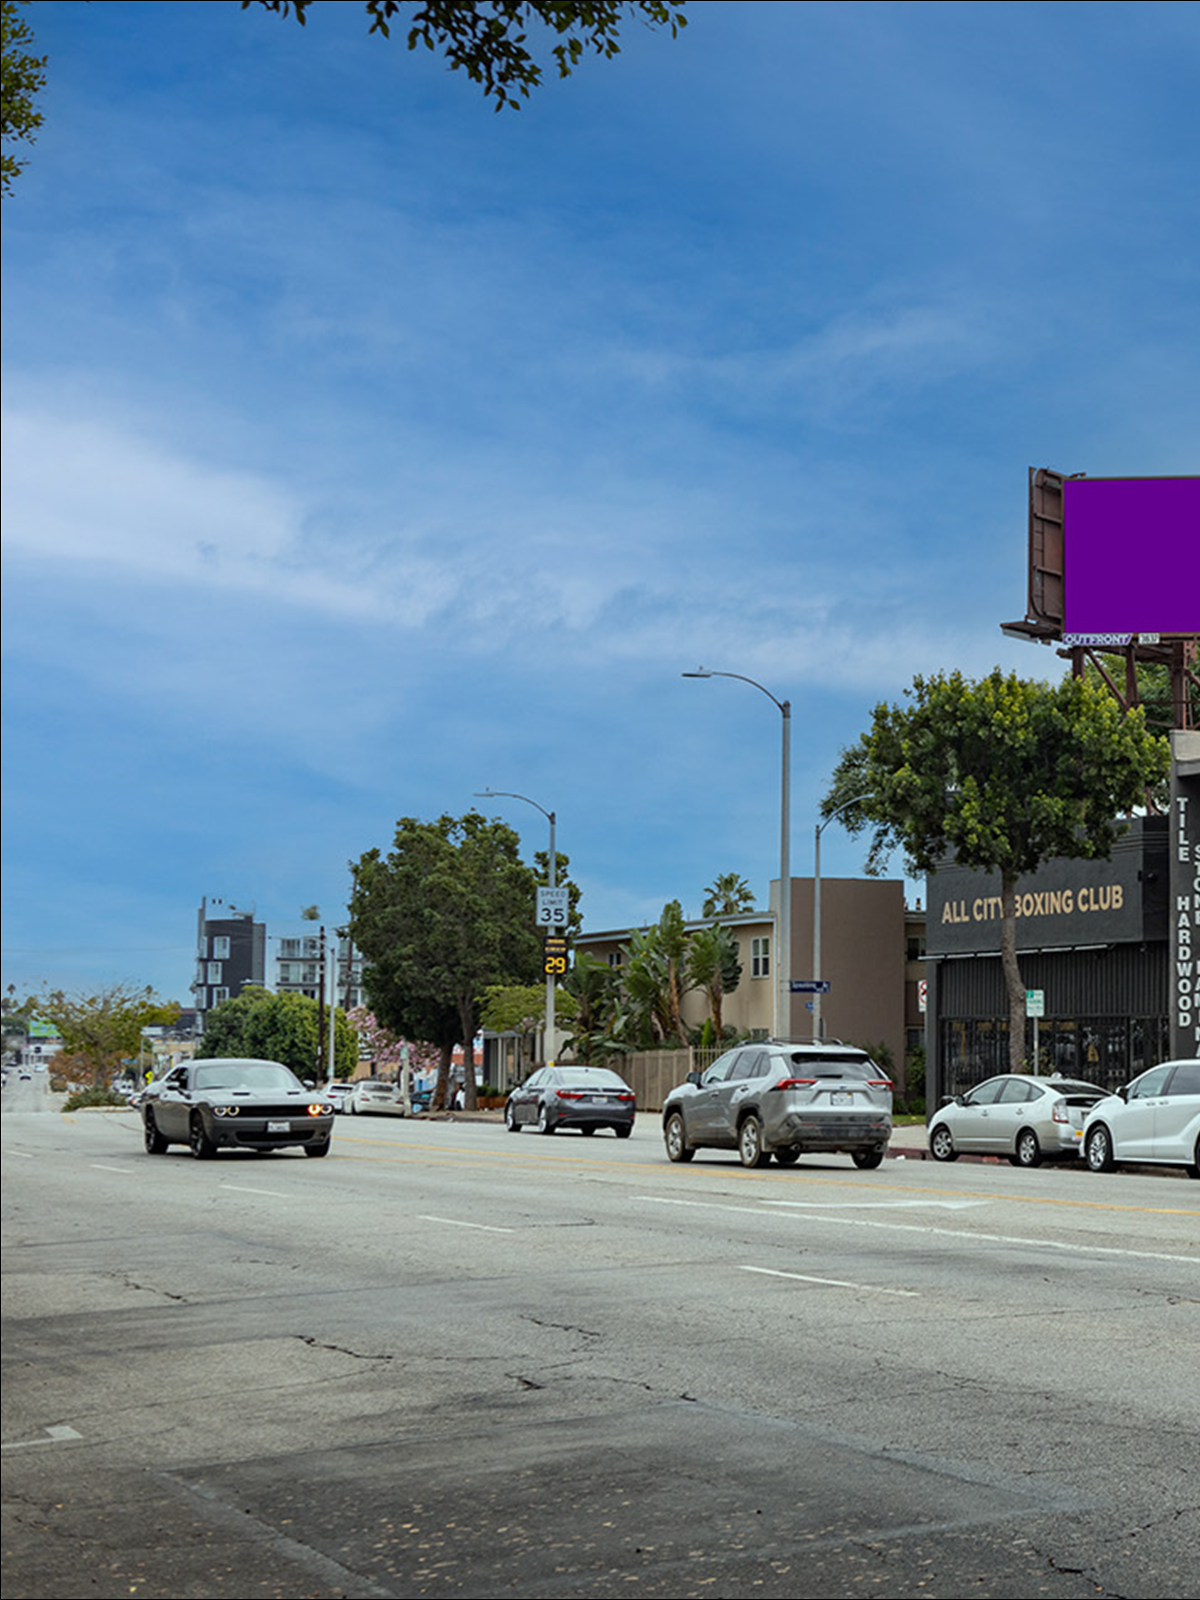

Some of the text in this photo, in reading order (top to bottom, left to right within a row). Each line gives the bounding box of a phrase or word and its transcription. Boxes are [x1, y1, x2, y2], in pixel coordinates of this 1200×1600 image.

[1177, 797, 1190, 862] TILE
[541, 890, 566, 898] SPEED
[942, 900, 970, 924] ALL
[1013, 889, 1074, 918] BOXING
[1077, 884, 1124, 912] CLUB
[541, 908, 565, 922] 35
[545, 957, 566, 974] 29
[1177, 896, 1192, 1027] HARDWOOD
